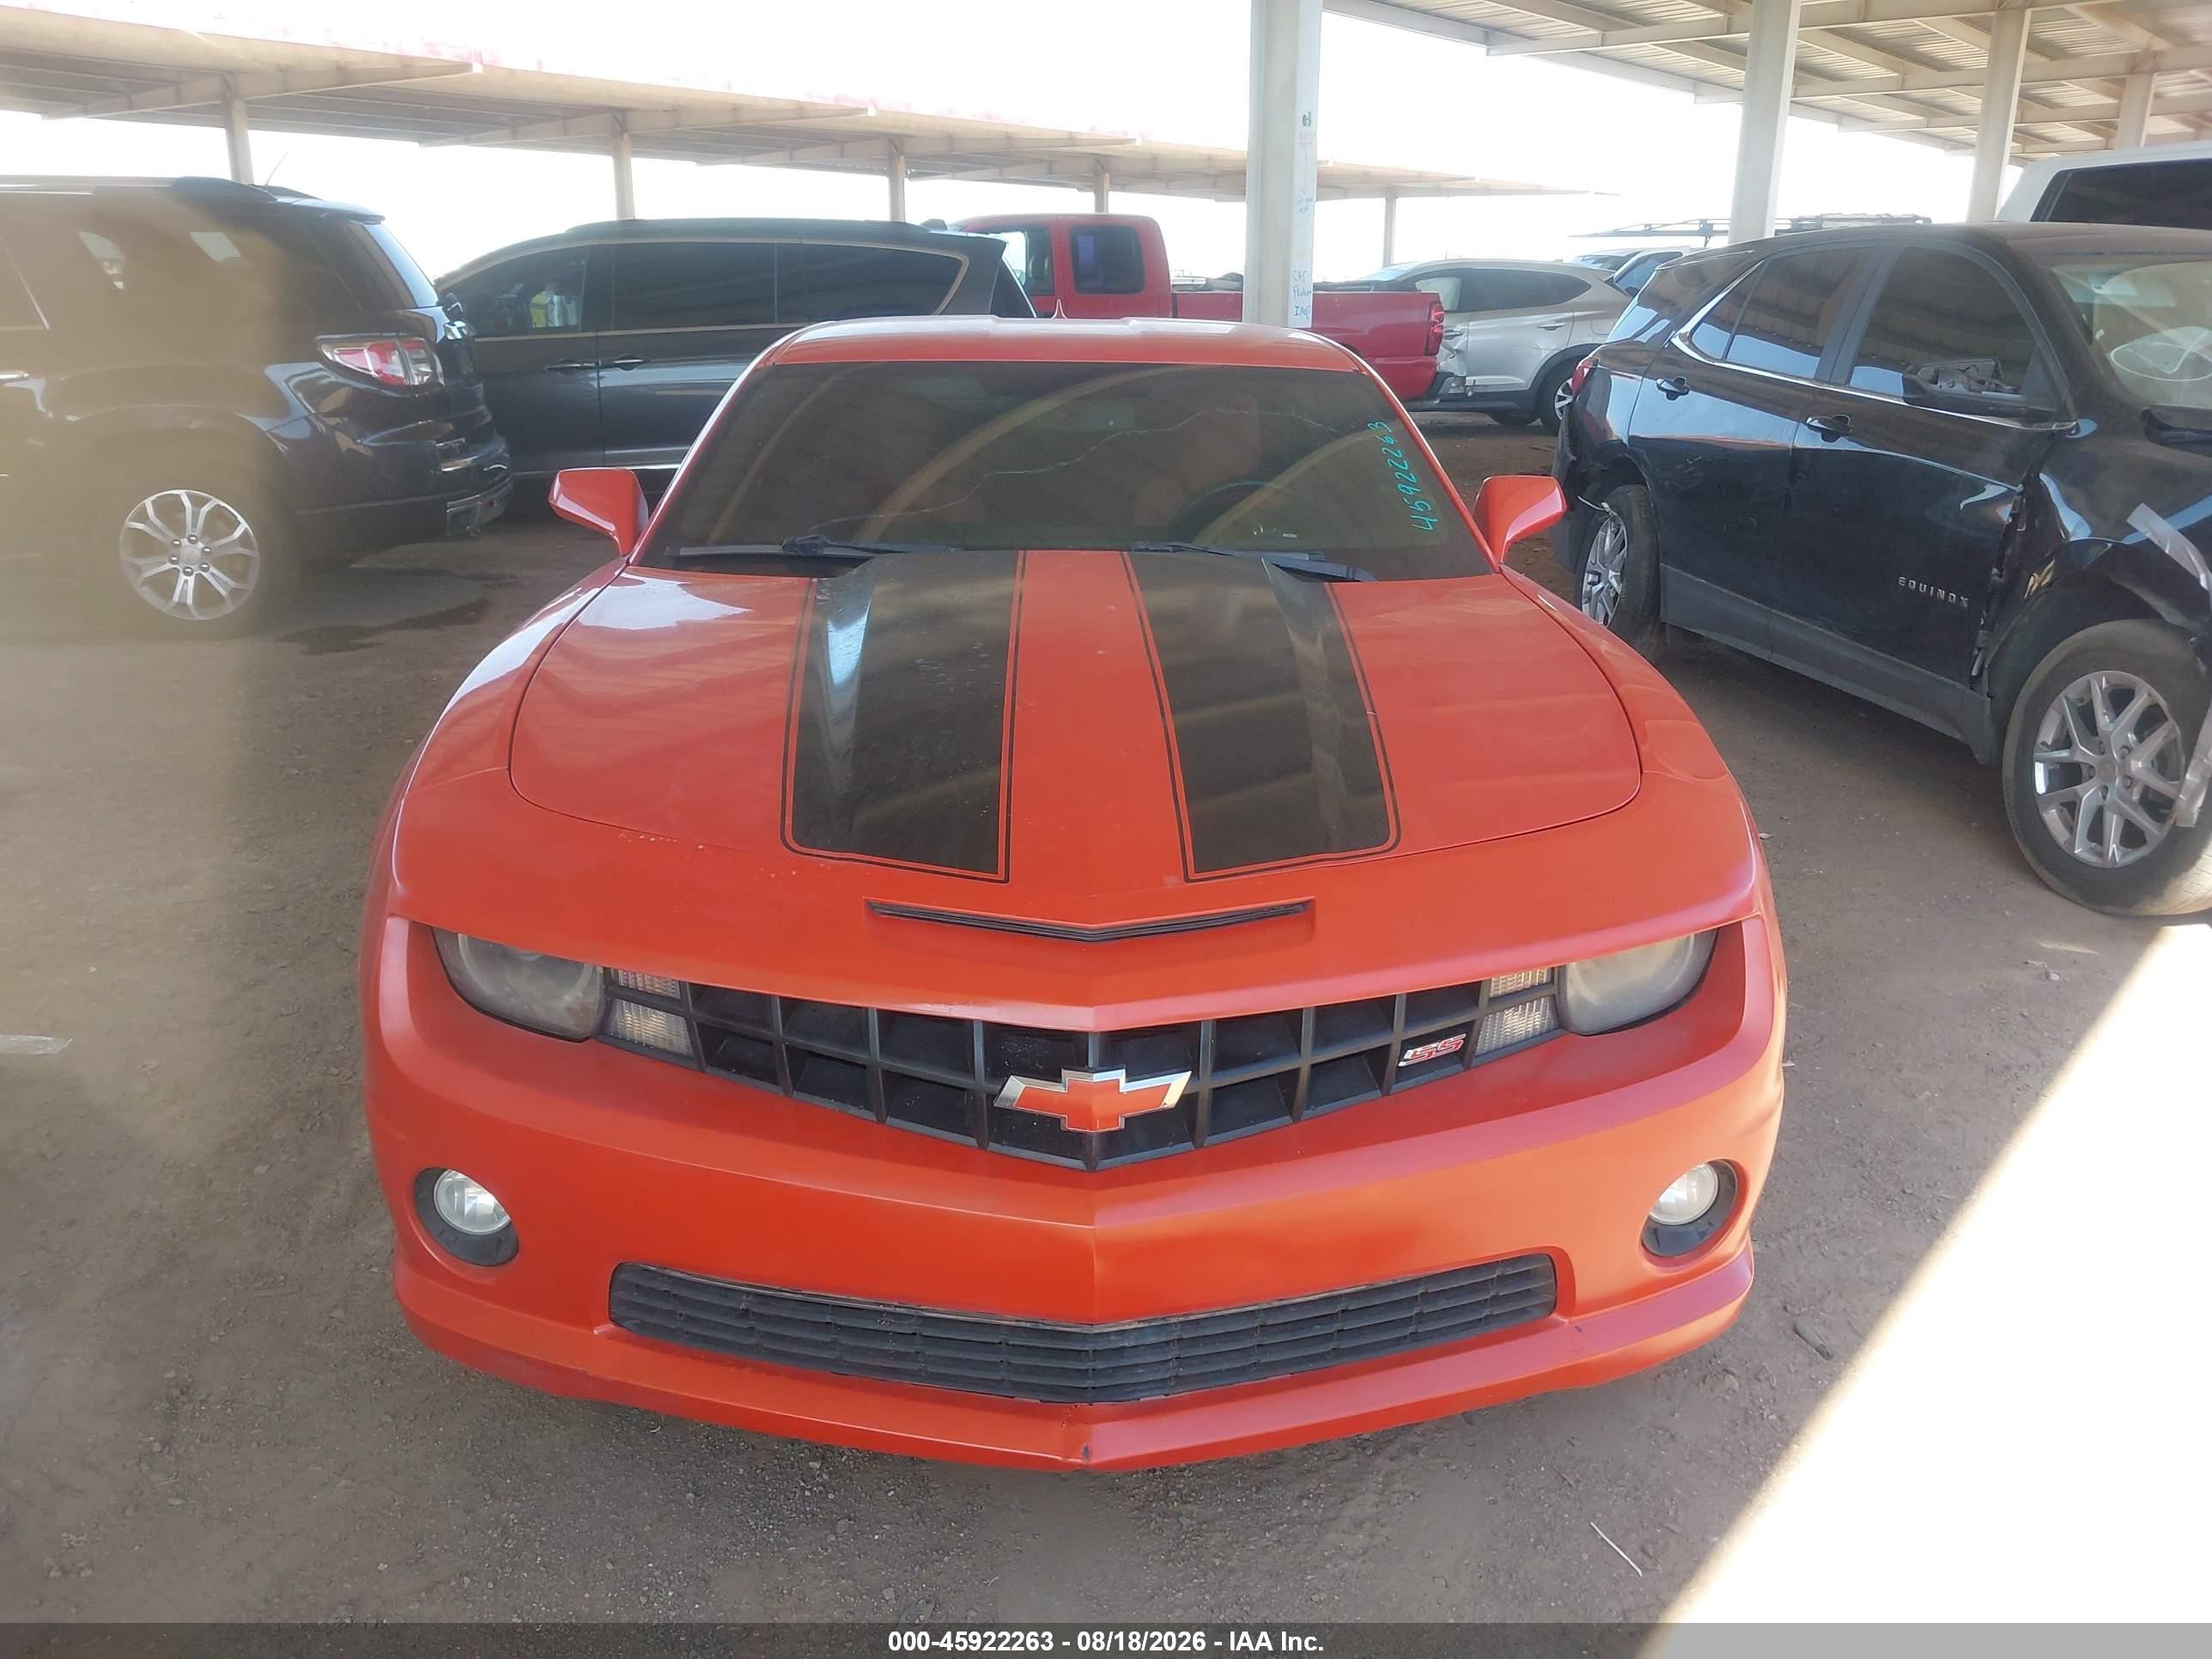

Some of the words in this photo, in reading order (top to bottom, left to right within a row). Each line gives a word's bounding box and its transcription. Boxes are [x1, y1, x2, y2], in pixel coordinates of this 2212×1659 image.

[1367, 421, 1438, 532] 45922263
[1898, 576, 1971, 608] EQUINOX
[1398, 1033, 1467, 1066] SS
